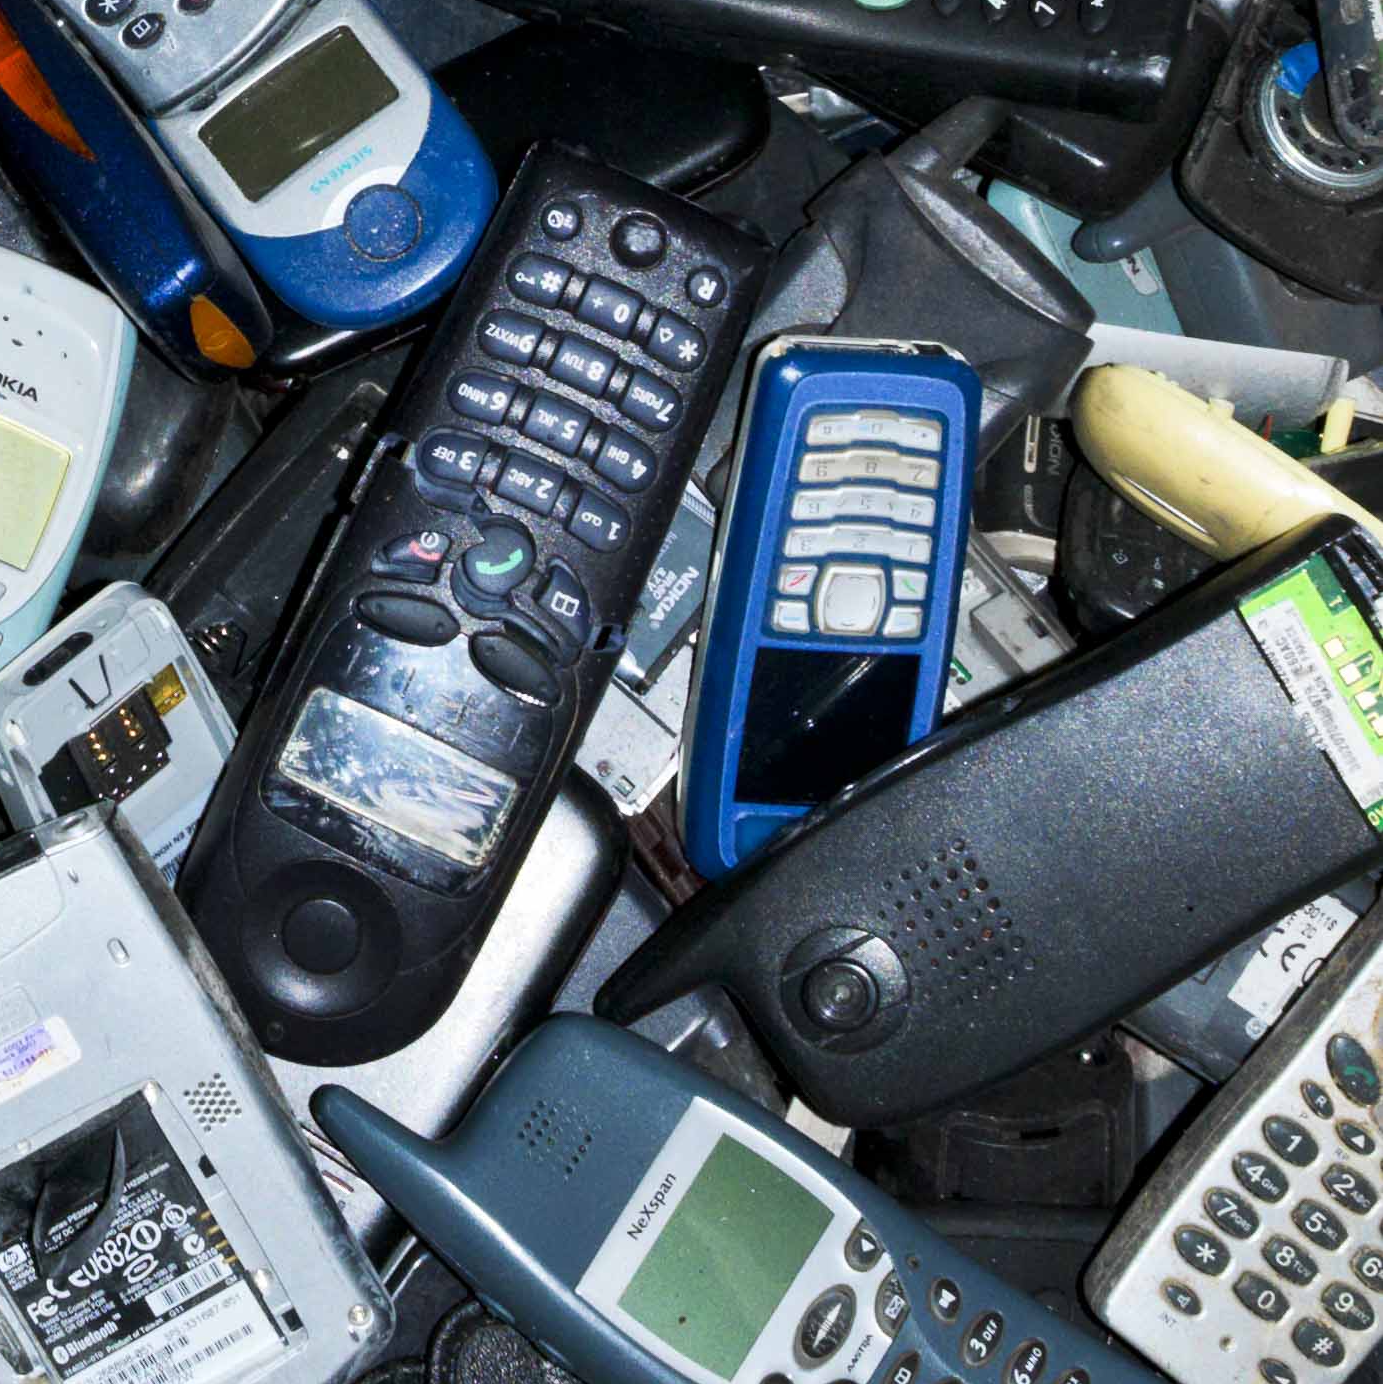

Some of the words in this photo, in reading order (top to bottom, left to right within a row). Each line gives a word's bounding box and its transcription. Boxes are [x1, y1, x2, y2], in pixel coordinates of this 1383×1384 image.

[309, 144, 374, 197] SIEMENS
[647, 559, 701, 630] NOKIA
[1287, 1135, 1302, 1153] 1
[625, 1171, 678, 1241] NeXspan
[64, 1318, 121, 1357] Bluetooth
